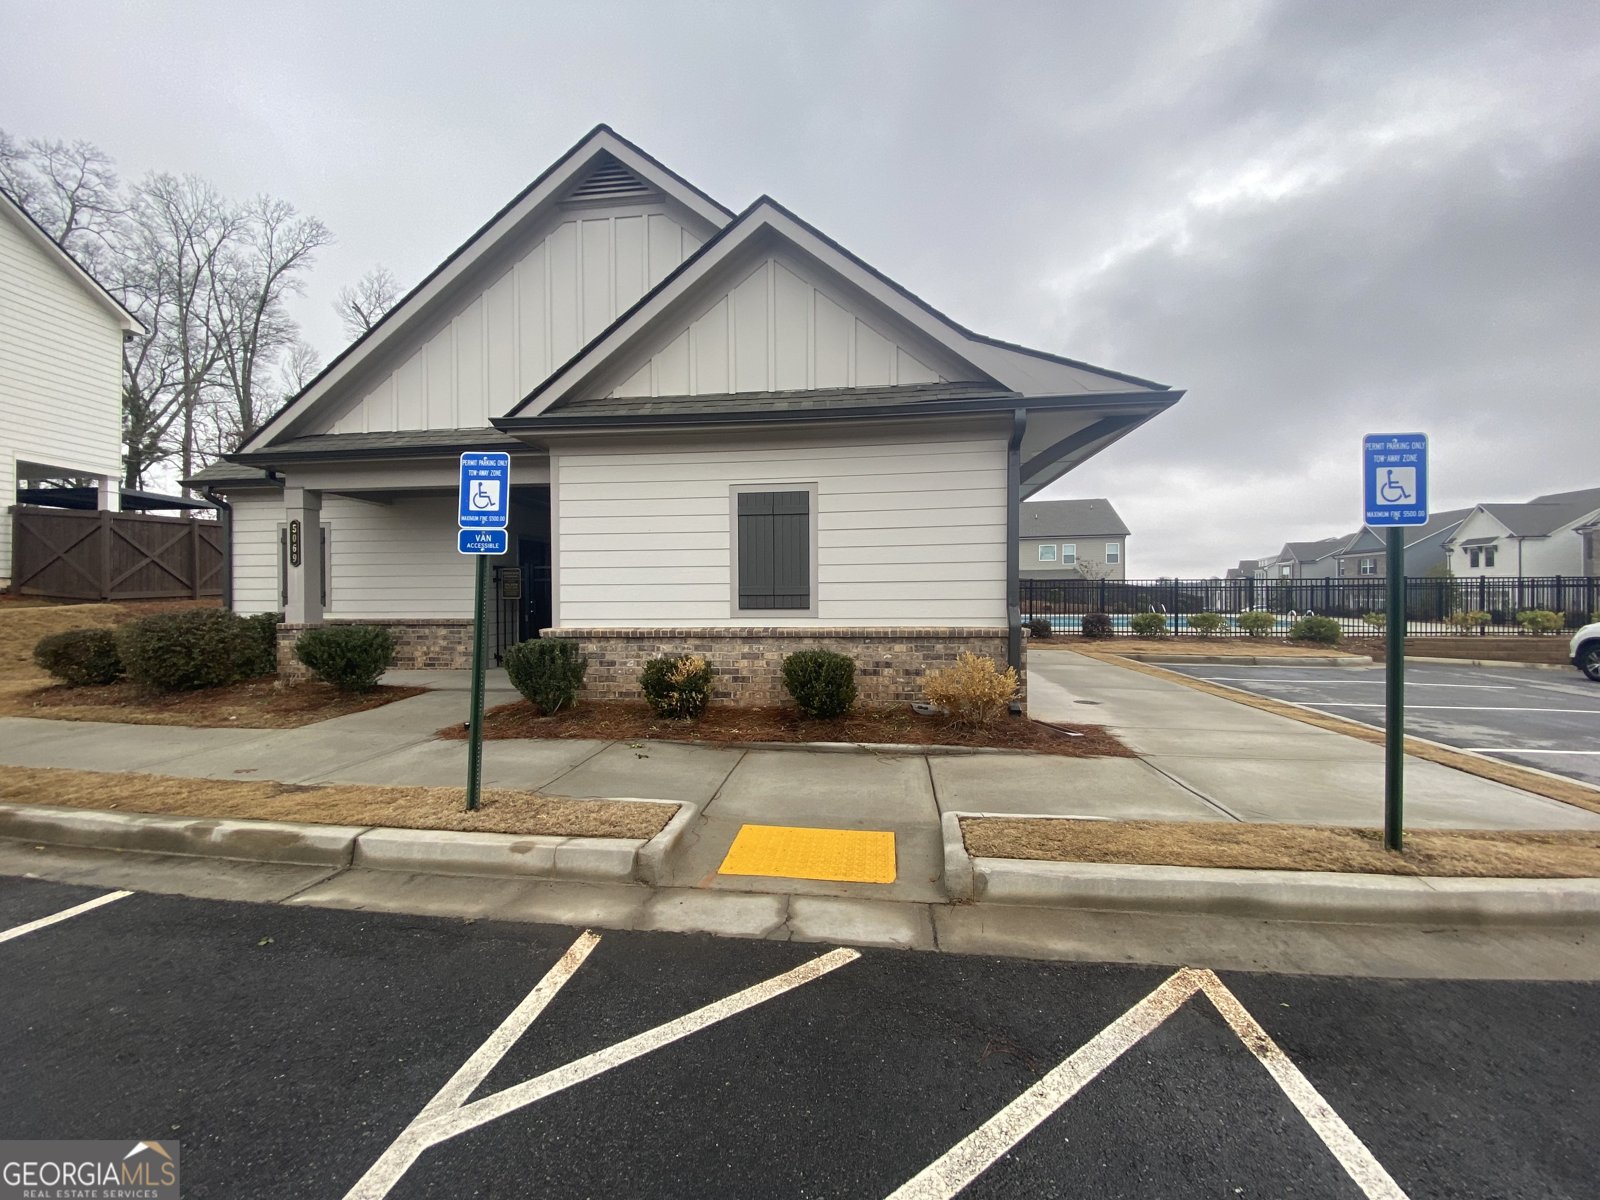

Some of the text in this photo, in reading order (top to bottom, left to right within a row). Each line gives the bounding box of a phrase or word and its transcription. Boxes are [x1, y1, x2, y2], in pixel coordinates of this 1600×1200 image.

[1365, 441, 1426, 451] PERMIT PARKING ONLY
[1373, 453, 1418, 463] TOW-AWAY ZONE
[479, 459, 496, 467] PARKING
[497, 459, 508, 467] ONLY
[468, 469, 502, 477] TOW-AWAY ZONE
[1390, 510, 1402, 518] FINE
[475, 534, 492, 542] VAN
